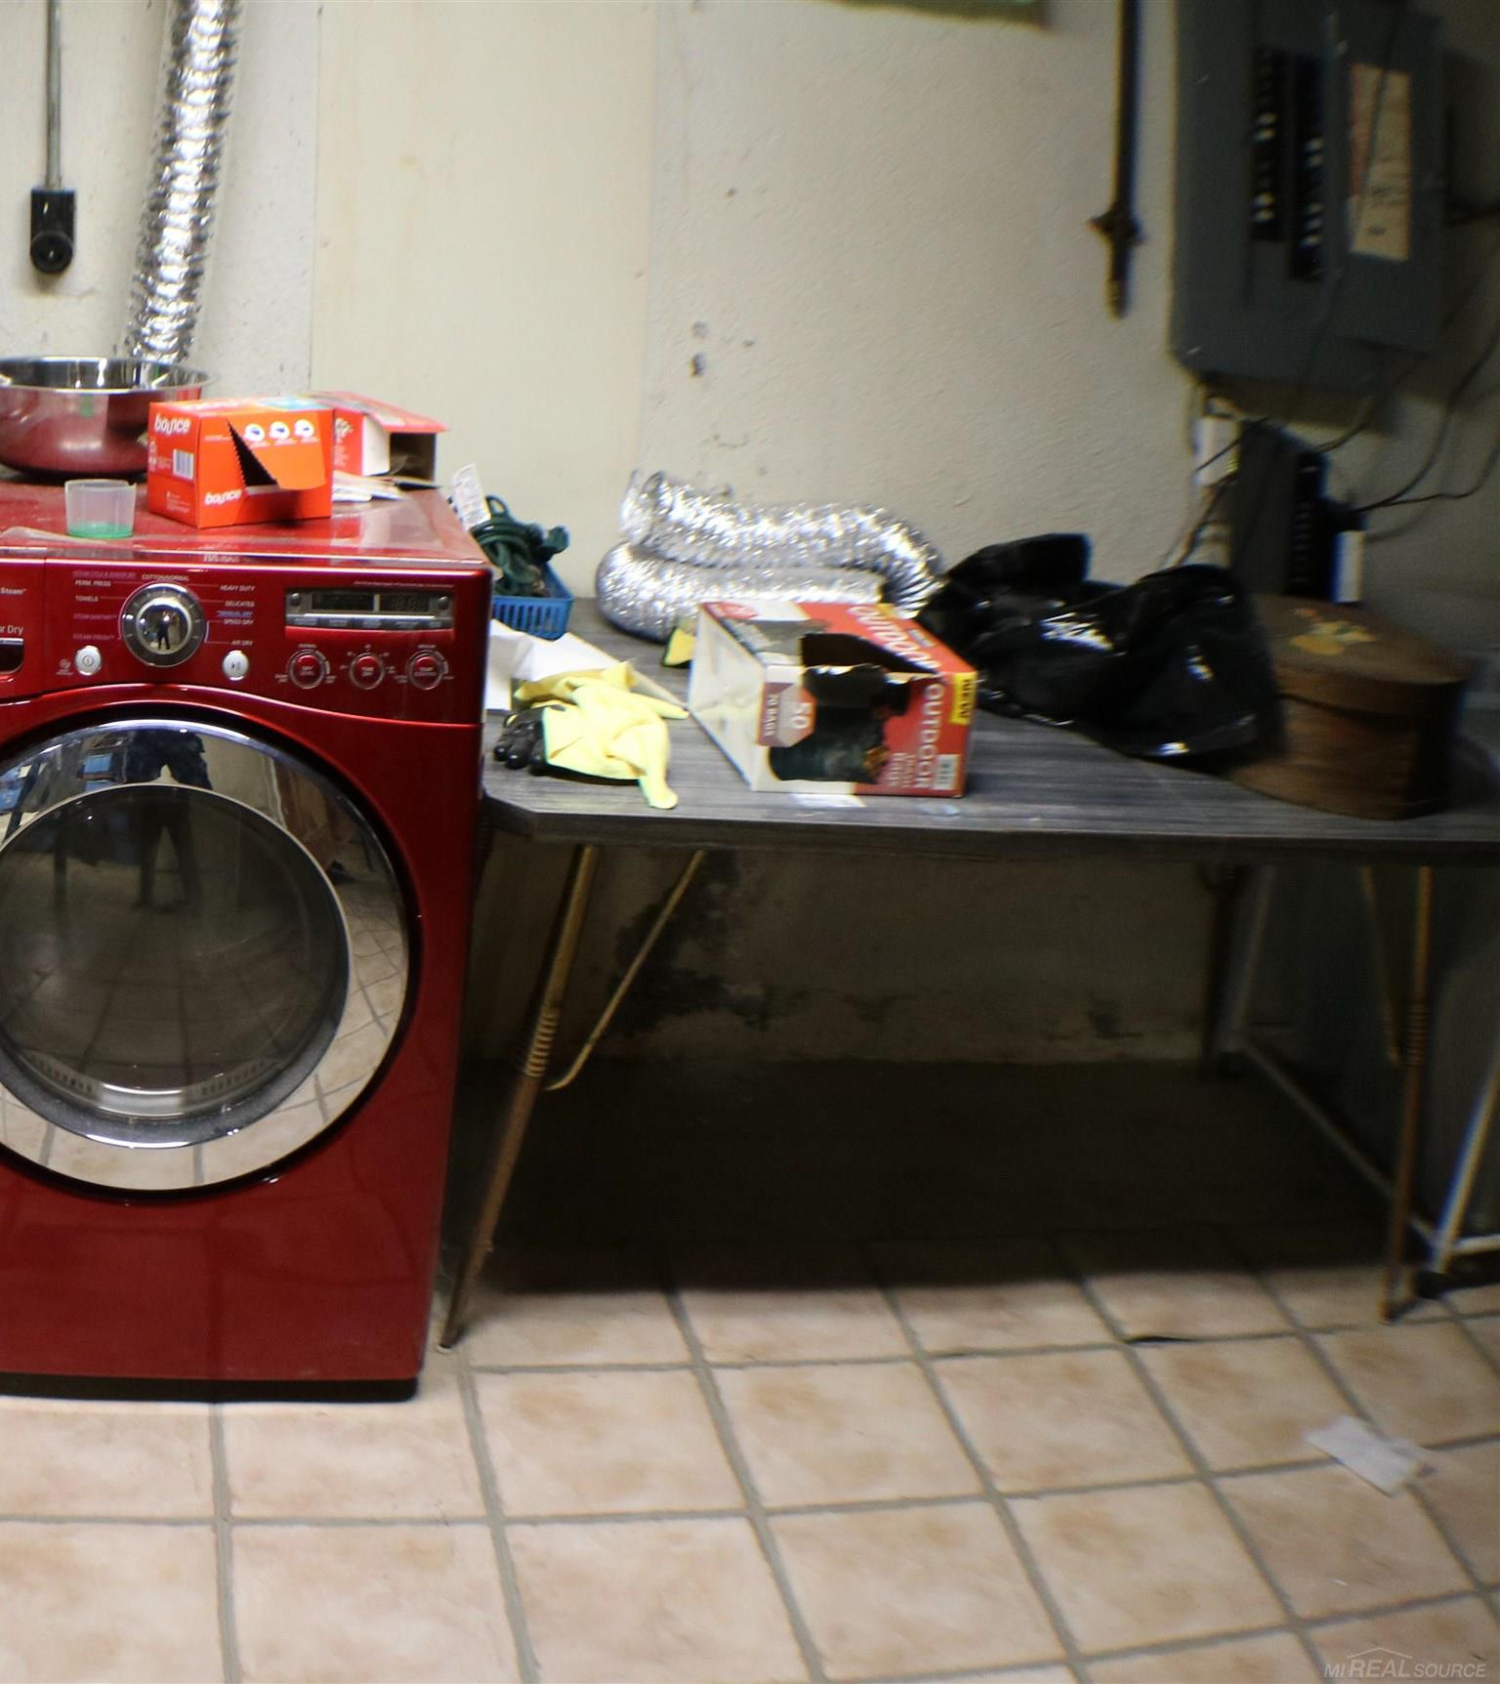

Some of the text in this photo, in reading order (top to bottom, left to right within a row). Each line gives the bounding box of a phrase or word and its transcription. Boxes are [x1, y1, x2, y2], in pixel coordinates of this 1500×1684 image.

[155, 414, 191, 435] bounce
[204, 488, 242, 506] bounce
[7, 624, 25, 636] Dry
[959, 678, 973, 719] NEW
[790, 702, 813, 729] 50
[915, 683, 946, 789] OUTDOOR
